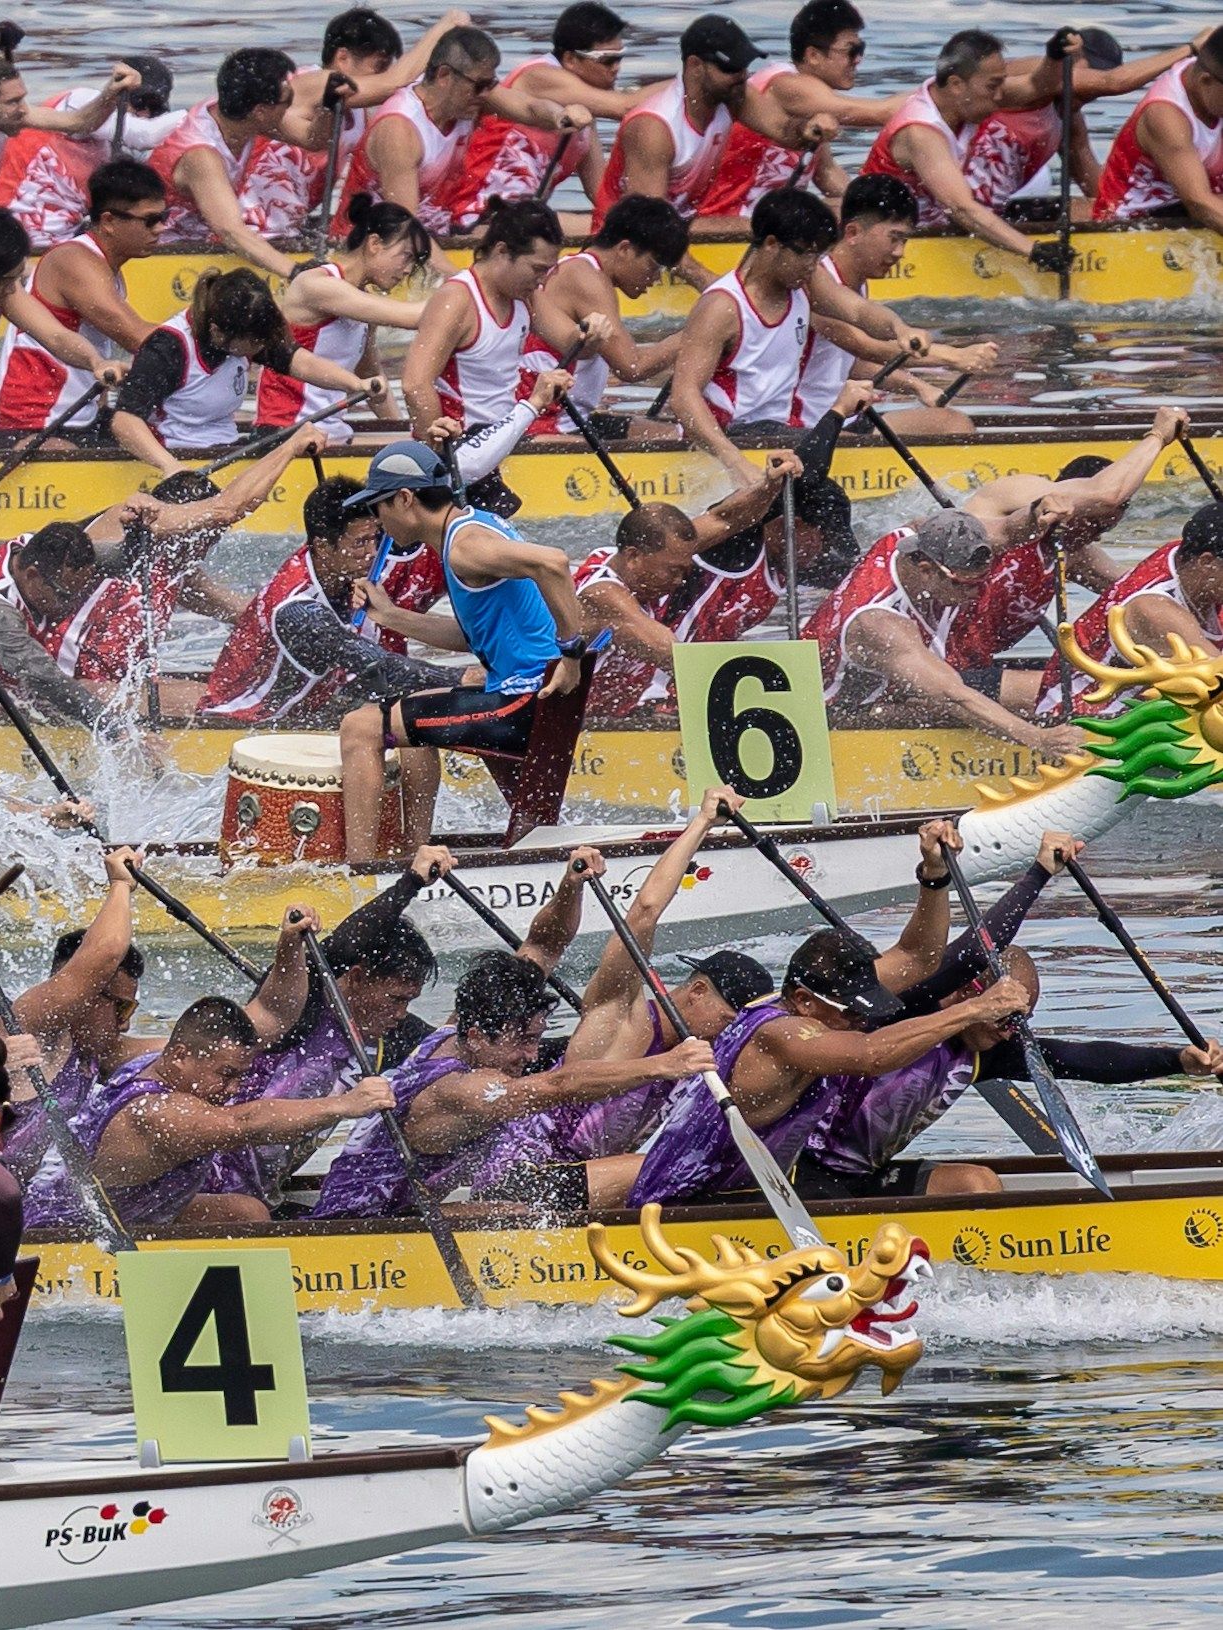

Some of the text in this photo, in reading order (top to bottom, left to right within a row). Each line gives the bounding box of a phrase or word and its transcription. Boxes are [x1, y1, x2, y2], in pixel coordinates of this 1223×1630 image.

[863, 467, 907, 490] Life
[18, 484, 66, 509] Life
[708, 656, 802, 799] 6
[950, 750, 1006, 777] Sun
[1000, 1225, 1111, 1260] Sun Life
[291, 1260, 407, 1293] Sun Life
[530, 1256, 586, 1284] Sun
[159, 1266, 276, 1426] 4
